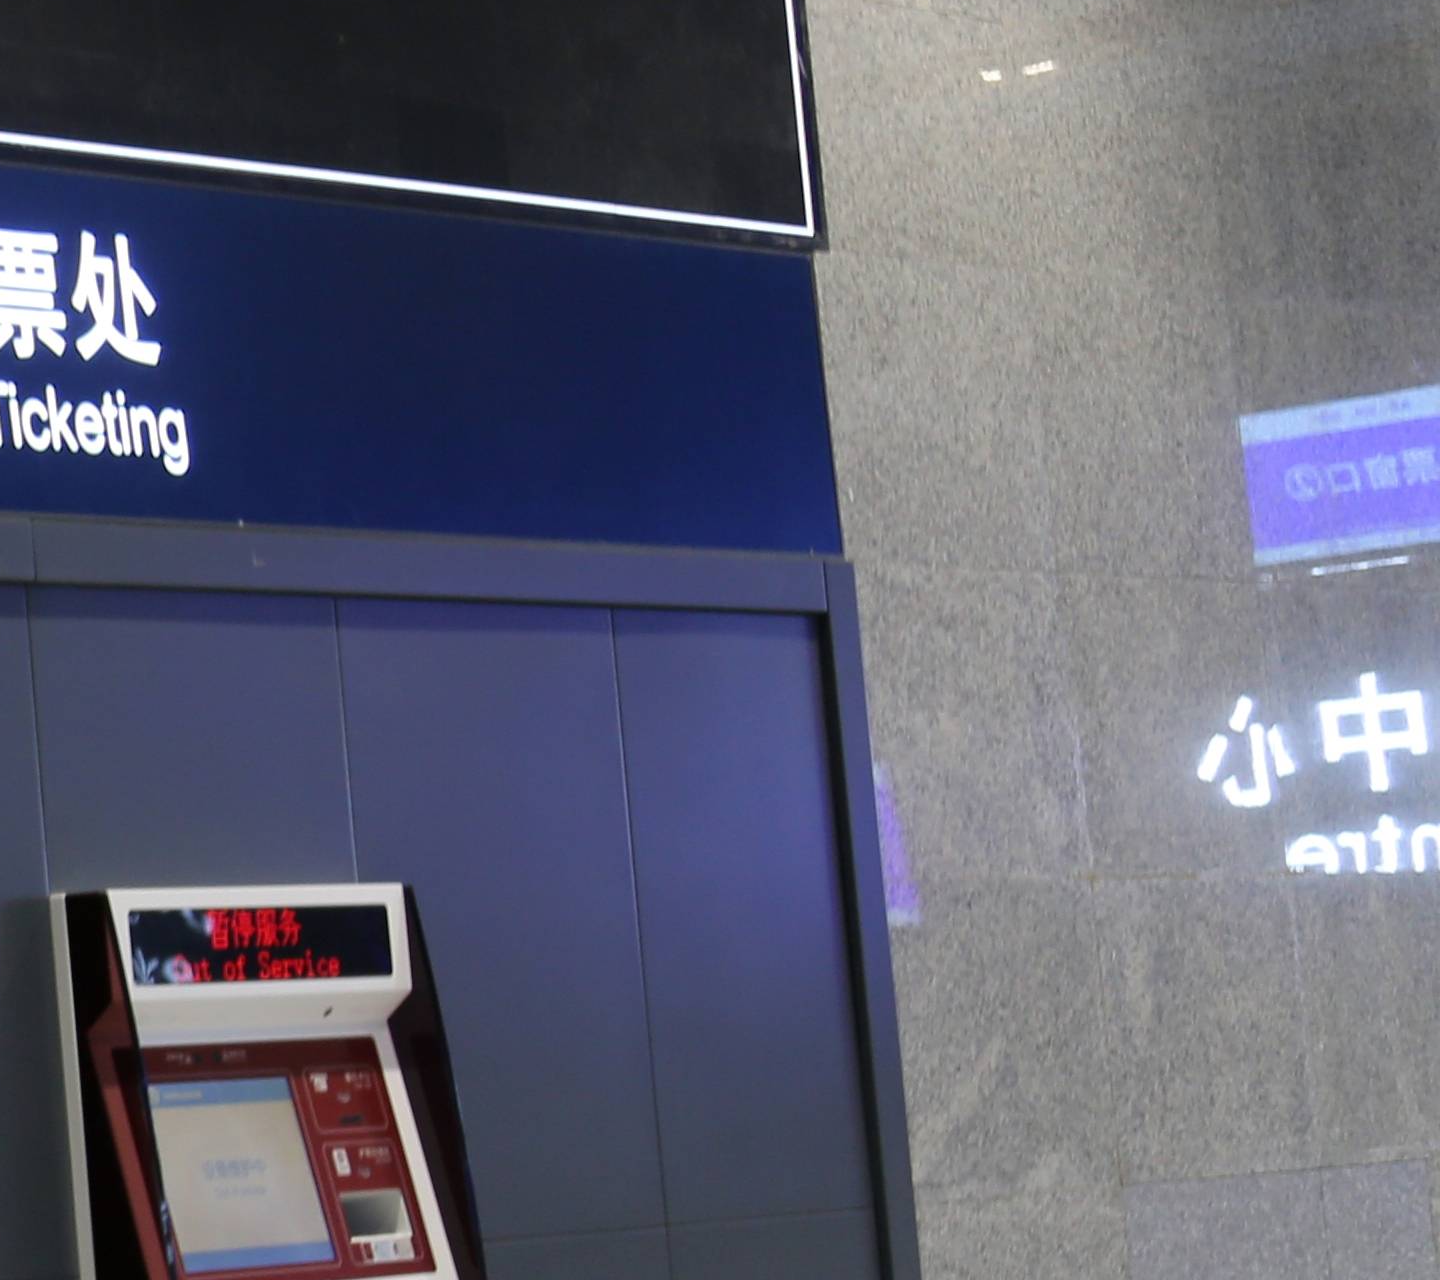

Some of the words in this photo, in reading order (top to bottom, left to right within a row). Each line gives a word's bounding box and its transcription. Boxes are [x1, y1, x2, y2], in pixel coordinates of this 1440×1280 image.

[209, 908, 302, 952] 暂停服务
[224, 954, 247, 982] of
[258, 949, 341, 980] Service
